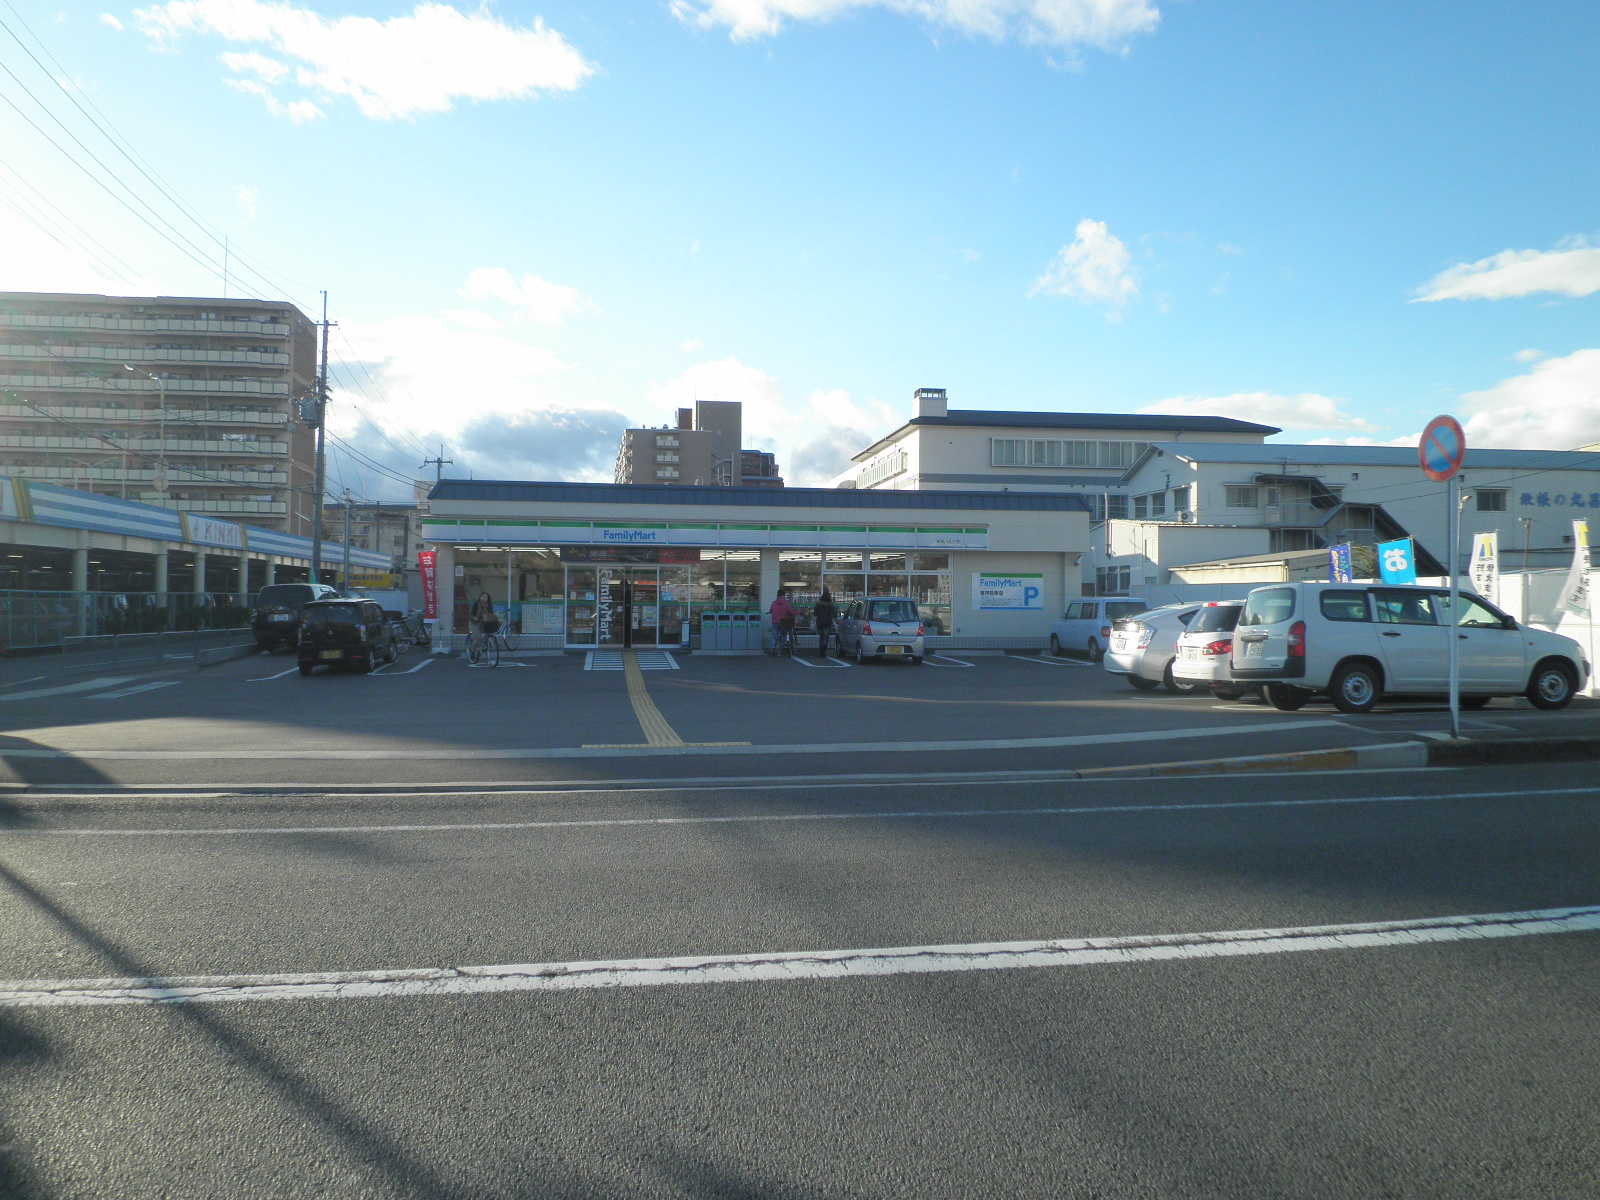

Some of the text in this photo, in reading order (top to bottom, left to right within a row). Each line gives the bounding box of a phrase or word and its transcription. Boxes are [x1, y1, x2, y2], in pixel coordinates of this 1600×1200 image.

[204, 520, 238, 546] KINKI
[603, 530, 656, 541] FamilyMart
[980, 579, 1022, 588] FamilyMart
[600, 570, 613, 640] FamilyMart
[1024, 586, 1040, 606] P
